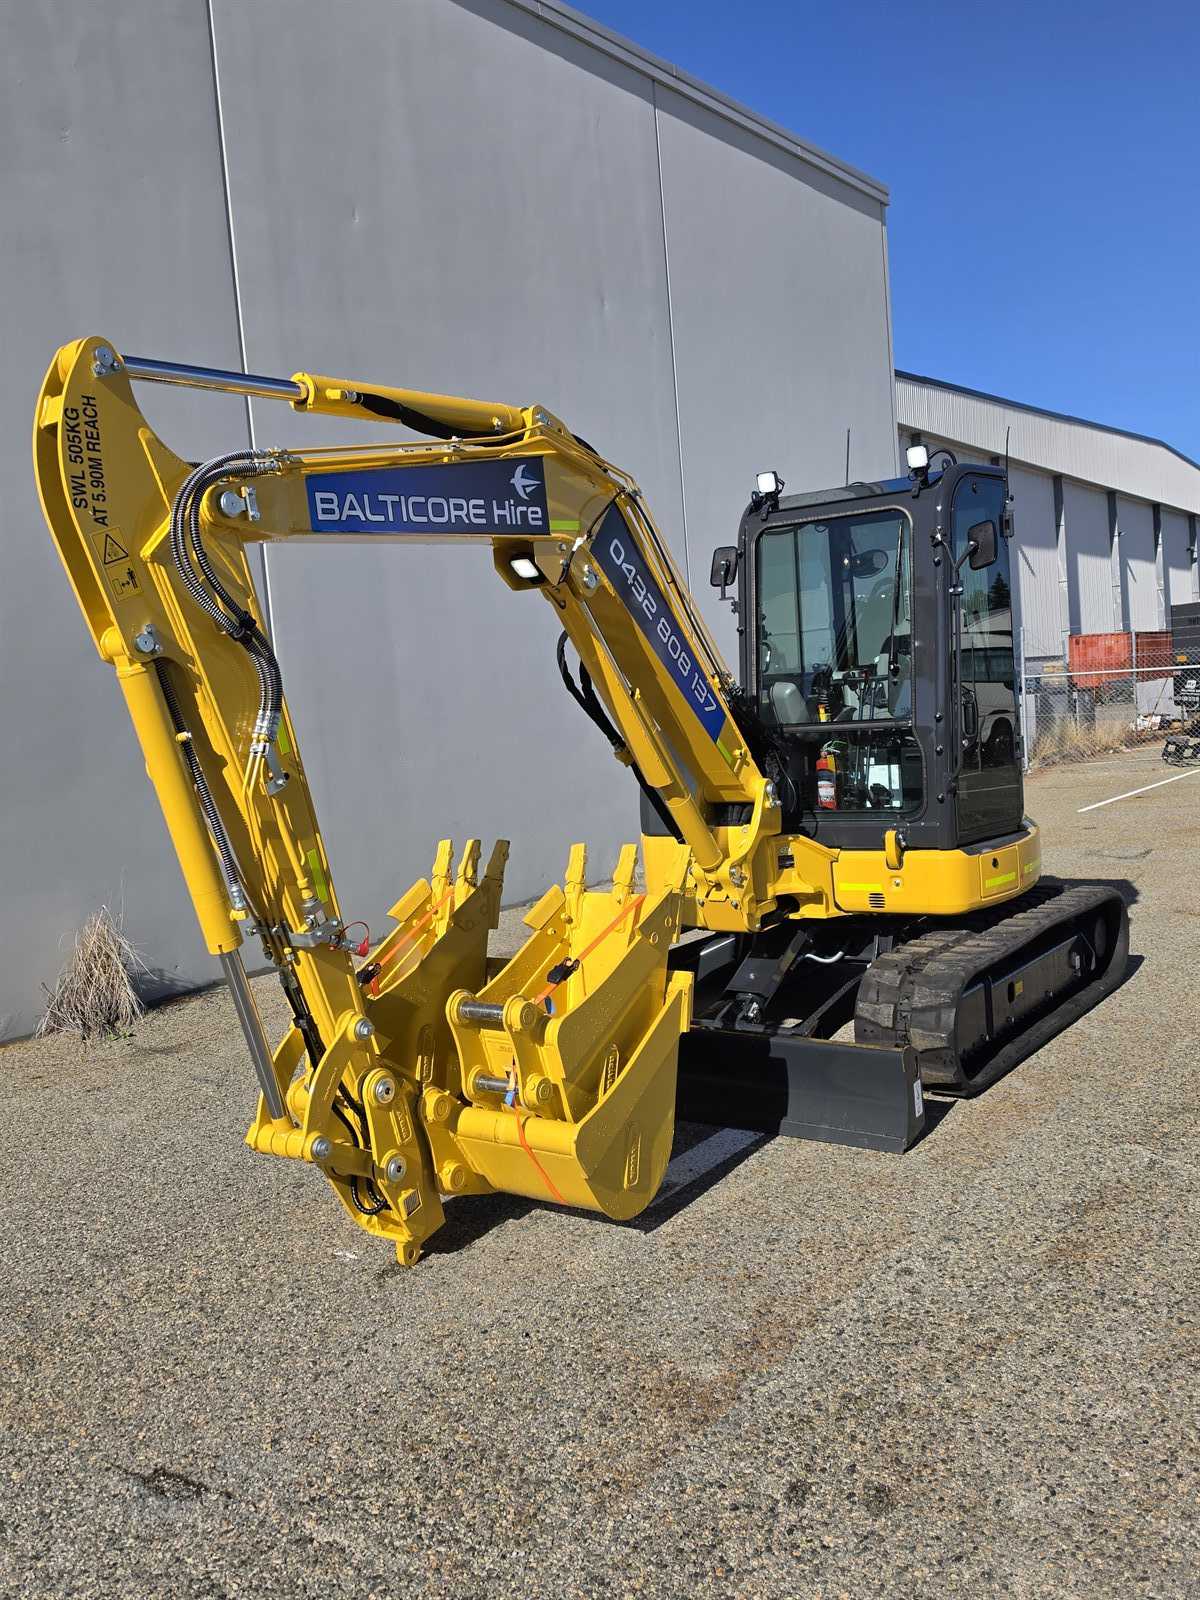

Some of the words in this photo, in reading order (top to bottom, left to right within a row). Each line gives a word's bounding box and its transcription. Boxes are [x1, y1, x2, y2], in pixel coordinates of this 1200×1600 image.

[64, 408, 84, 464] 505KG
[82, 395, 101, 453] REACH
[73, 470, 88, 509] SWL
[88, 457, 106, 502] 5.90M
[92, 506, 109, 527] AT
[314, 491, 487, 525] BALTICORE
[493, 500, 543, 526] Hire
[609, 538, 658, 620] 0432
[656, 617, 692, 678] 808
[691, 672, 717, 713] 137
